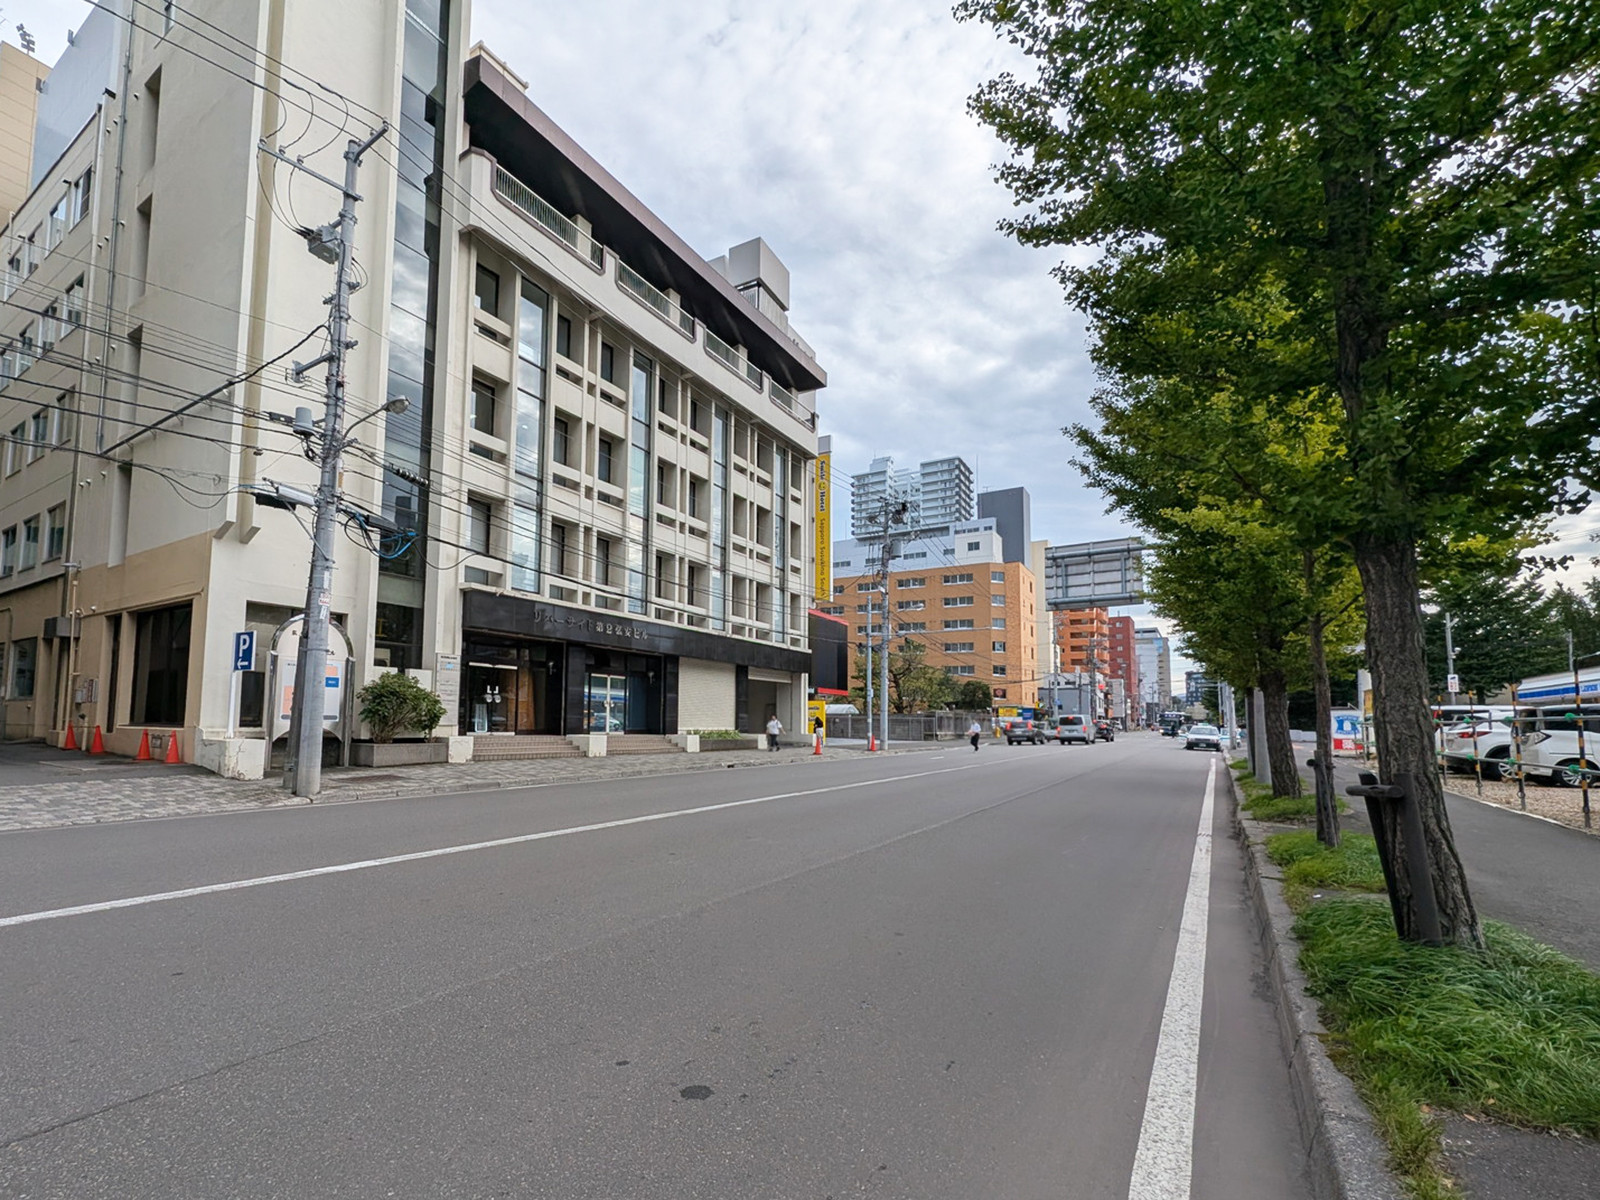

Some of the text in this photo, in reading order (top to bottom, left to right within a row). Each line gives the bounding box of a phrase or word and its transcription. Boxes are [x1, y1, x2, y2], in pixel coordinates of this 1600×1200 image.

[819, 460, 827, 512] Smile Hotel
[238, 634, 250, 657] P
